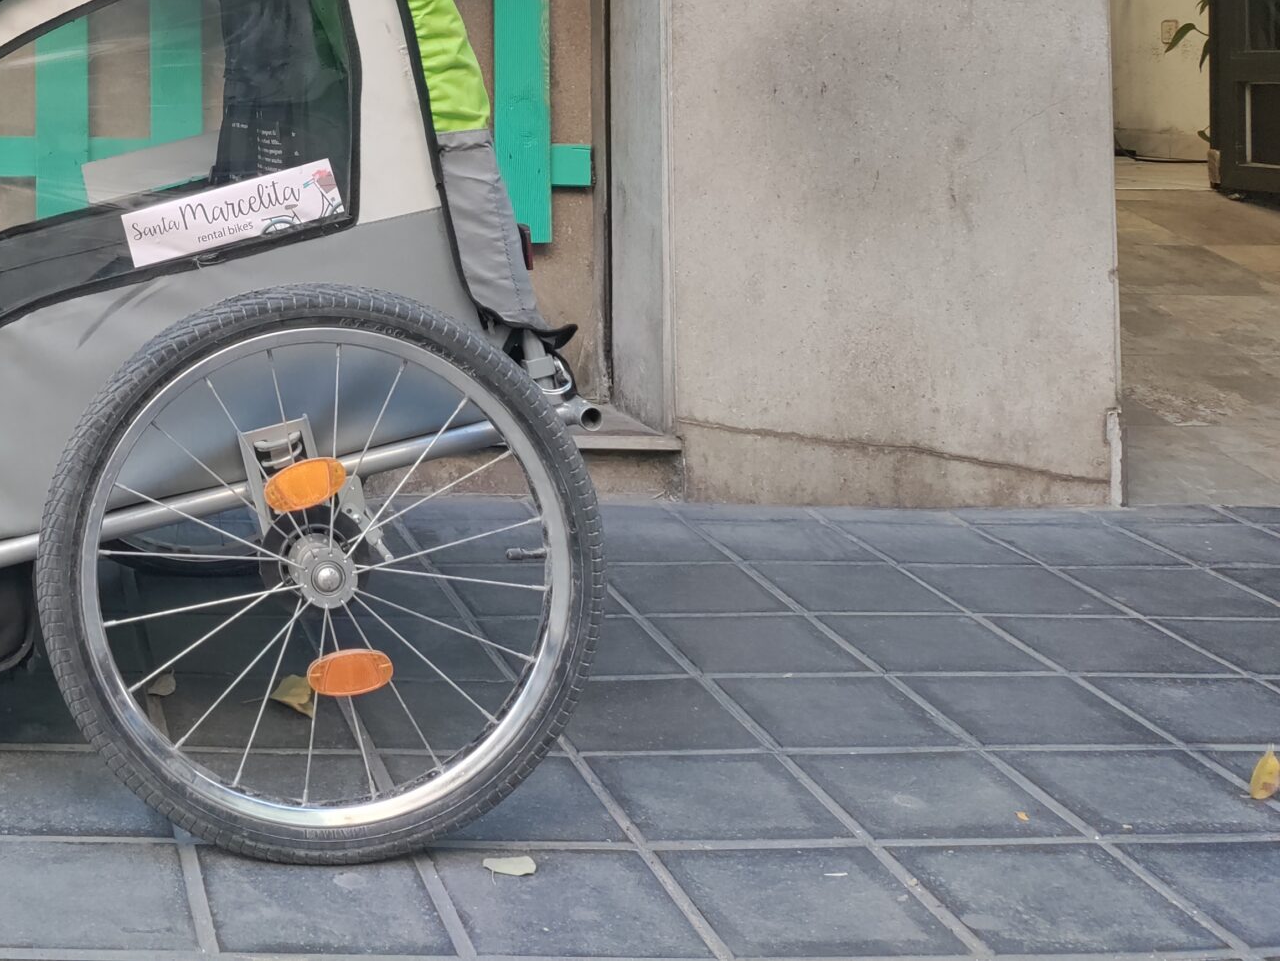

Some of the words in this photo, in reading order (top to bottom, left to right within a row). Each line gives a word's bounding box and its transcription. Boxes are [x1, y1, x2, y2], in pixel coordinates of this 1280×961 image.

[131, 218, 181, 241] Santa
[179, 180, 301, 231] Marcelita
[197, 227, 227, 244] rental
[227, 220, 254, 235] bikes
